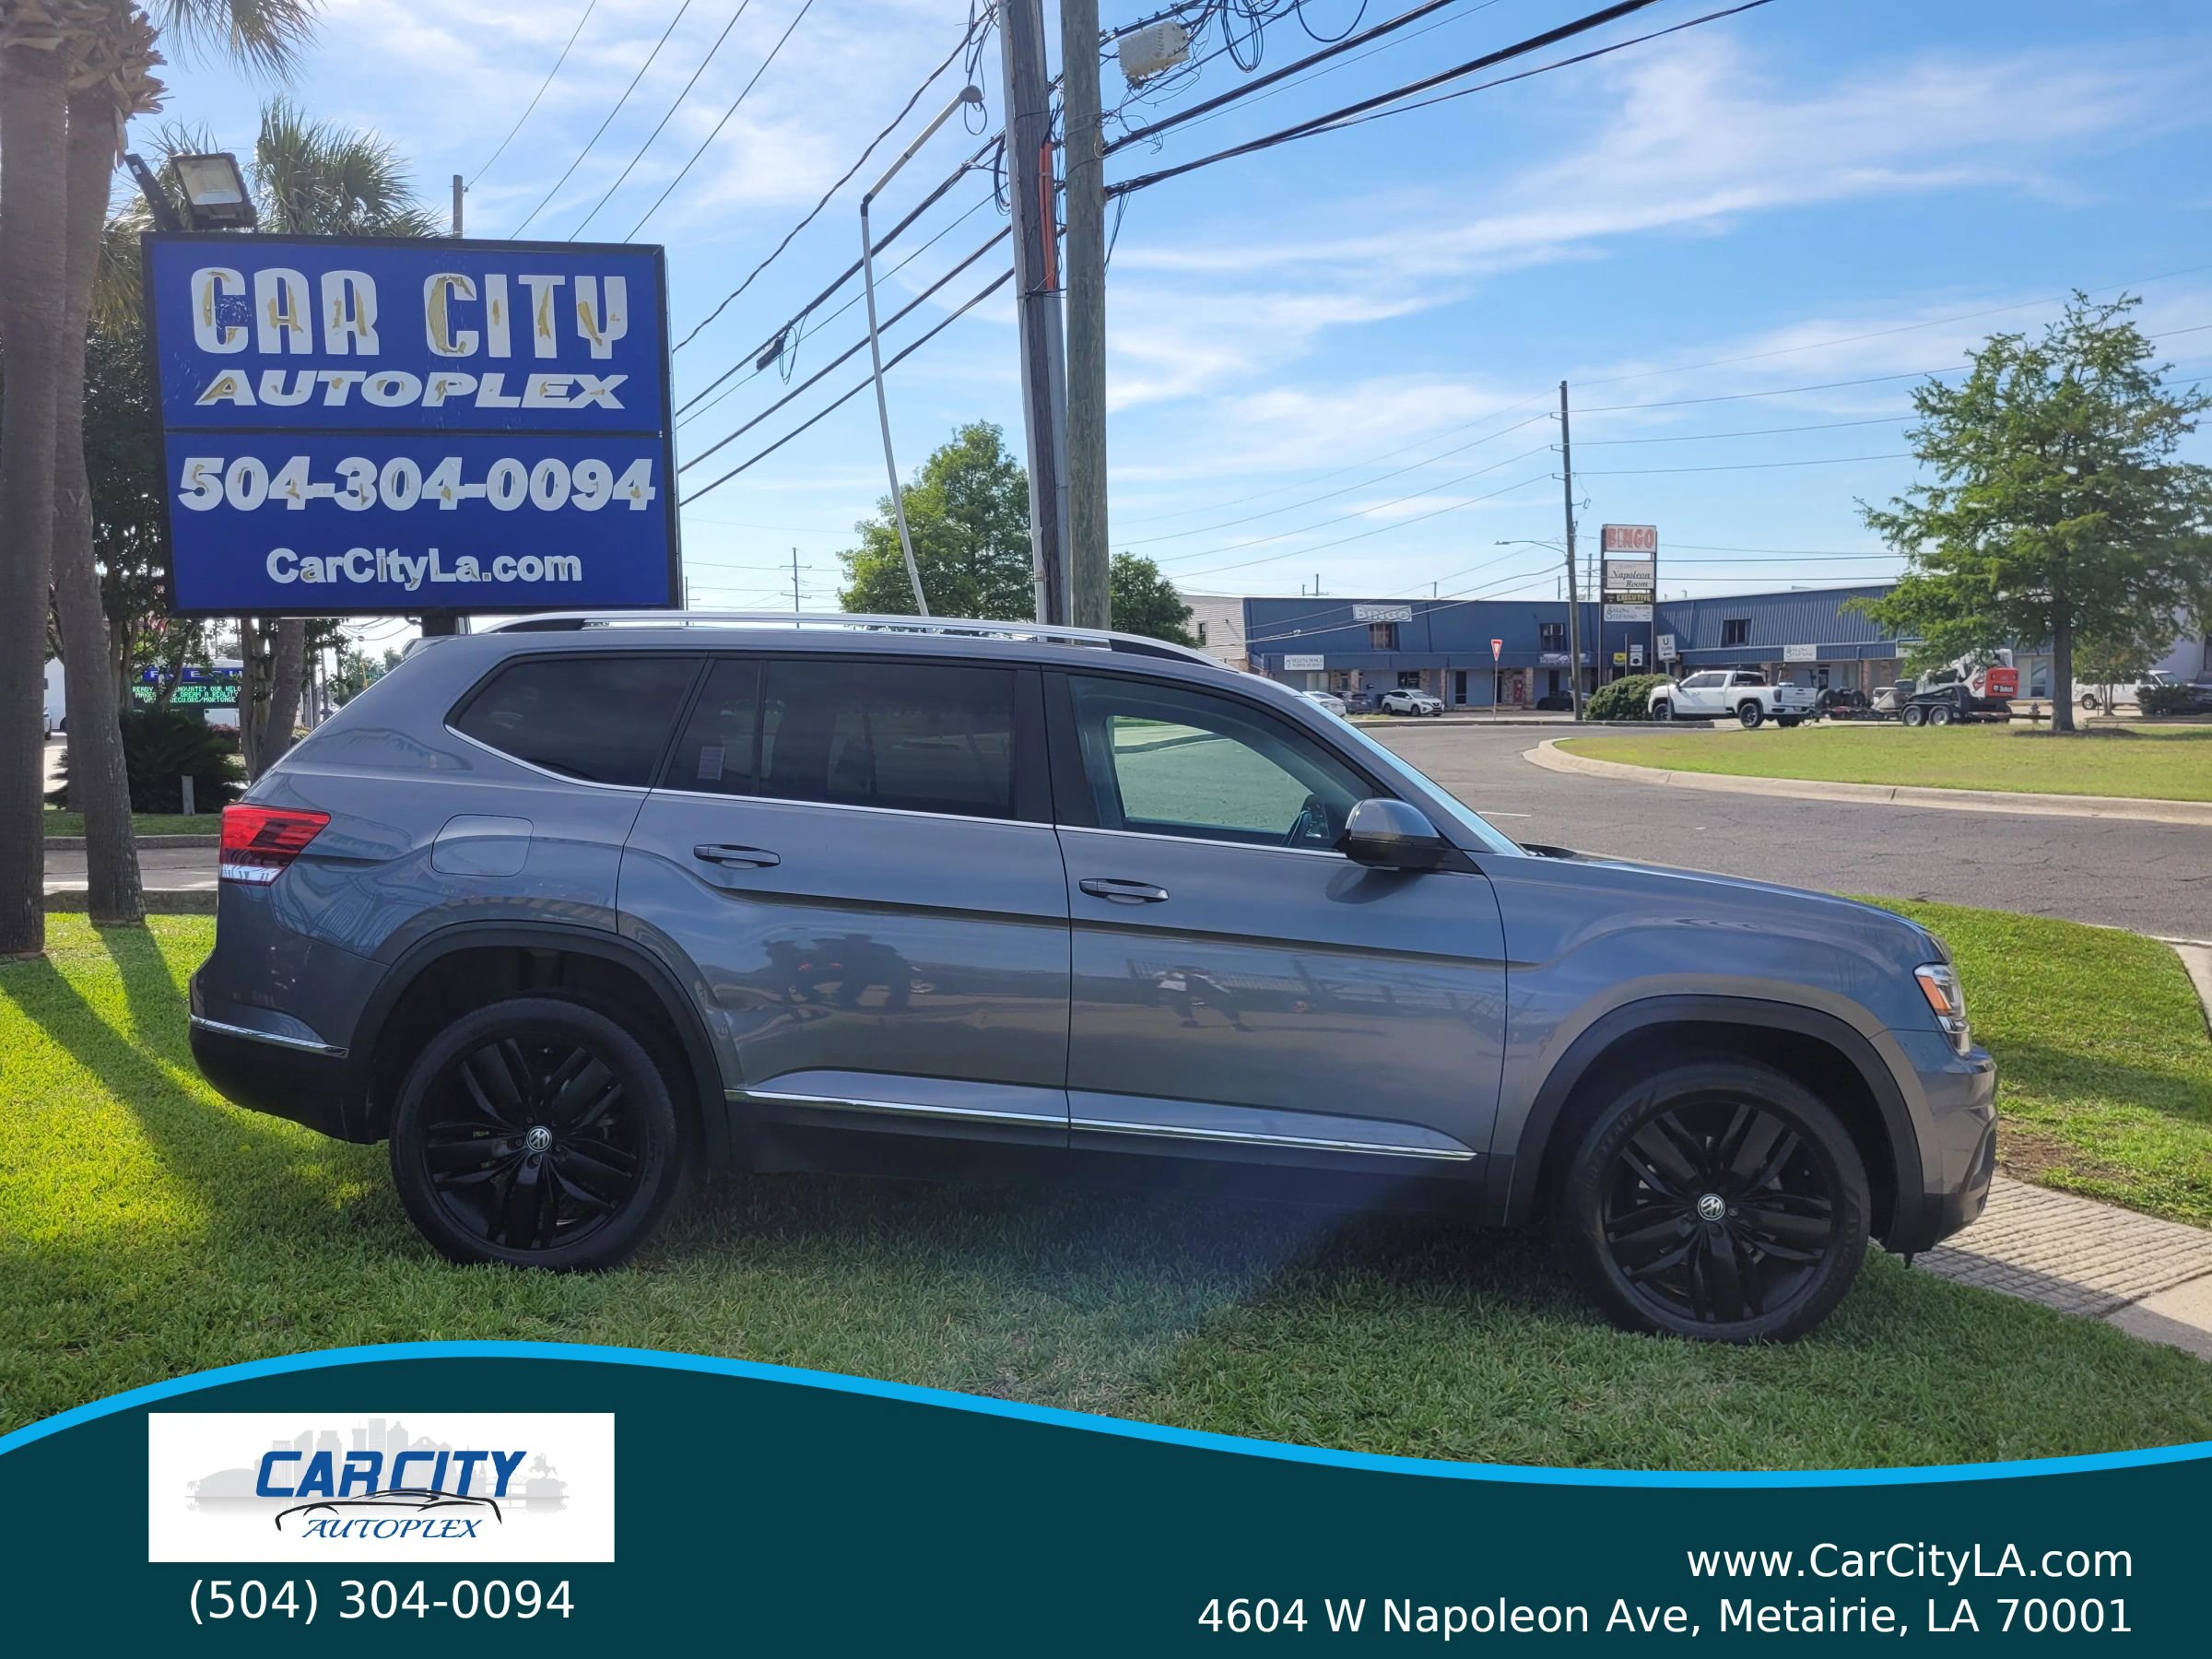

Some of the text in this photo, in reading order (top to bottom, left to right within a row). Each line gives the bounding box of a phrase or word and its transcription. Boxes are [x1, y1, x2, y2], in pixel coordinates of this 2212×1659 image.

[191, 267, 628, 359] CAR CITY
[195, 369, 629, 409] AUTOPLEX
[178, 455, 656, 512] 504-304-0094
[1606, 528, 1654, 549] BINGO
[266, 547, 582, 591] CarCityLa.com
[1613, 571, 1651, 580] Napoleon
[1355, 609, 1410, 621] BINGO
[1663, 637, 1669, 645] U
